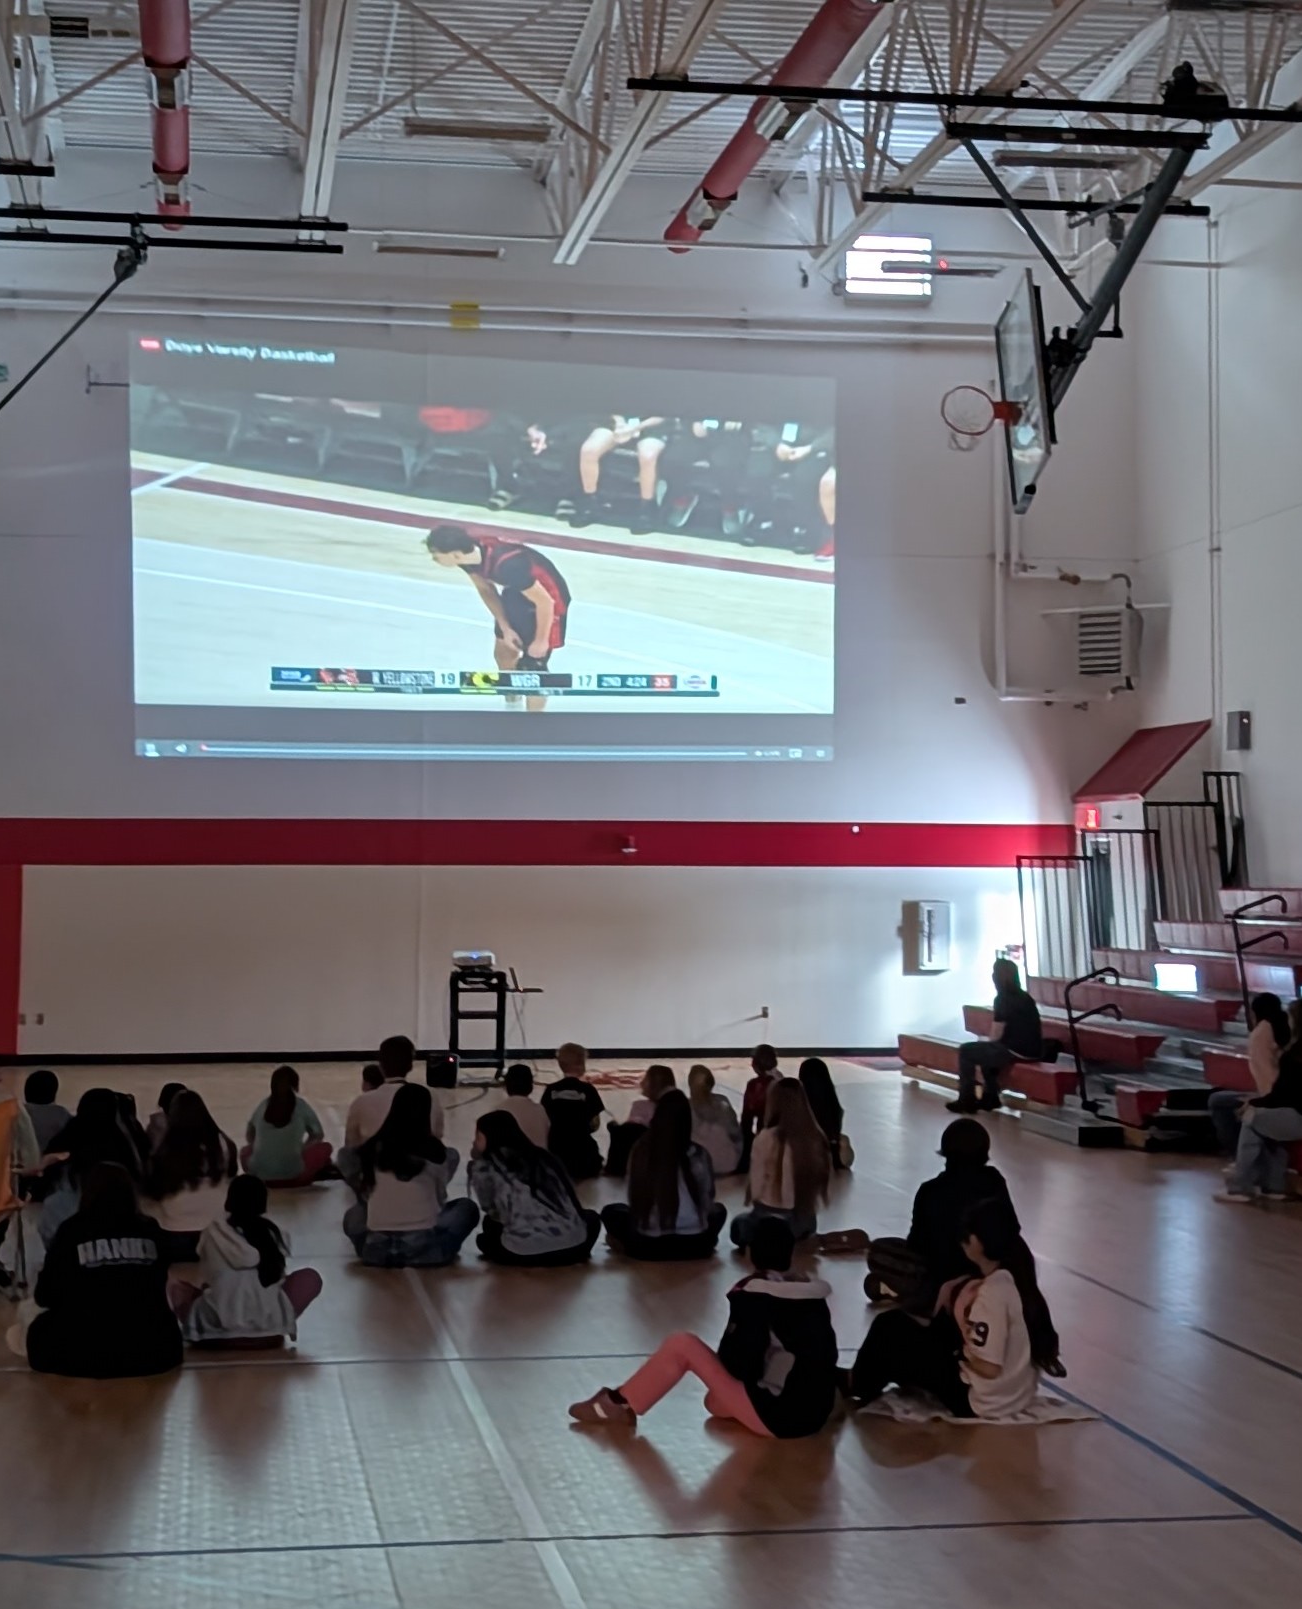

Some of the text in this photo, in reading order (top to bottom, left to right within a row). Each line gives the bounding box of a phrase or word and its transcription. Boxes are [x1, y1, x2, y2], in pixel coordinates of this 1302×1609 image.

[205, 343, 257, 362] Varsity
[260, 346, 336, 364] Basketball
[440, 673, 456, 685] 19
[578, 675, 593, 687] 17
